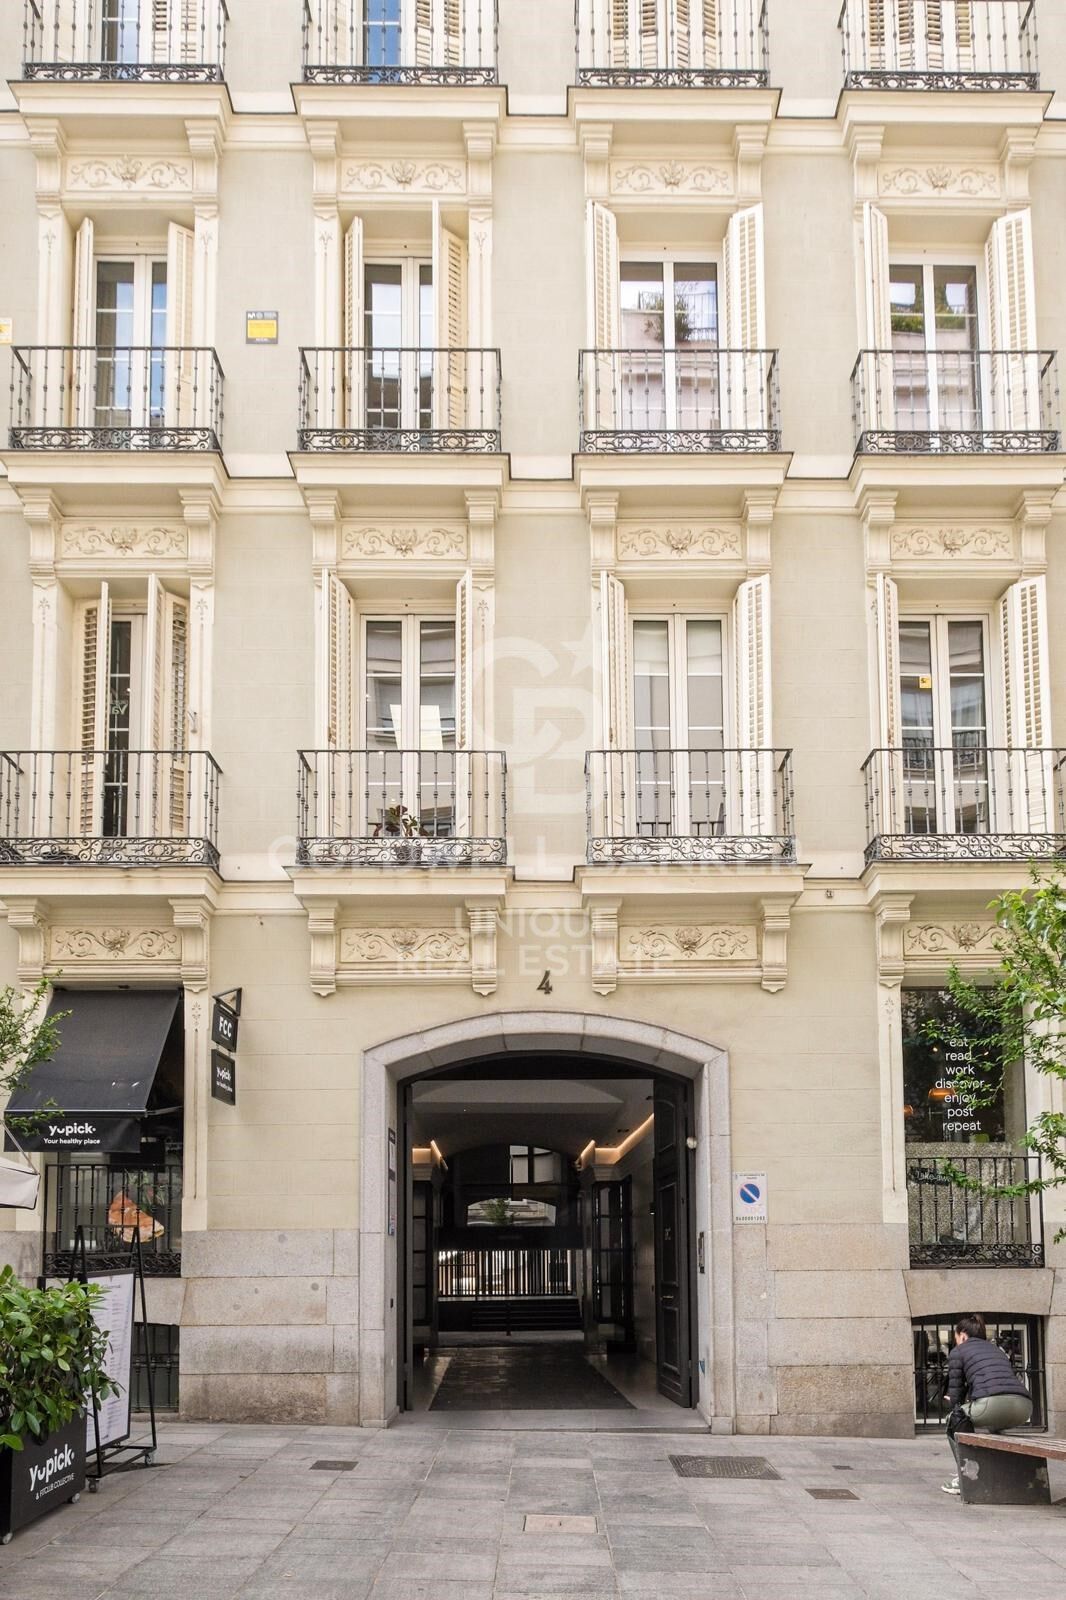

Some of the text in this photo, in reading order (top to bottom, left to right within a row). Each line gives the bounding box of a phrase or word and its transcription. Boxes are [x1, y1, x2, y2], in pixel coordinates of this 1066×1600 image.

[536, 970, 553, 995] 4
[218, 1015, 233, 1038] FCC
[949, 1037, 969, 1047] eat
[945, 1050, 972, 1061] read
[945, 1064, 976, 1075] work
[944, 1093, 977, 1105] enjoy
[947, 1107, 974, 1119] post
[942, 1121, 982, 1133] repeat
[59, 1138, 82, 1146] healthy
[83, 1138, 101, 1146] place
